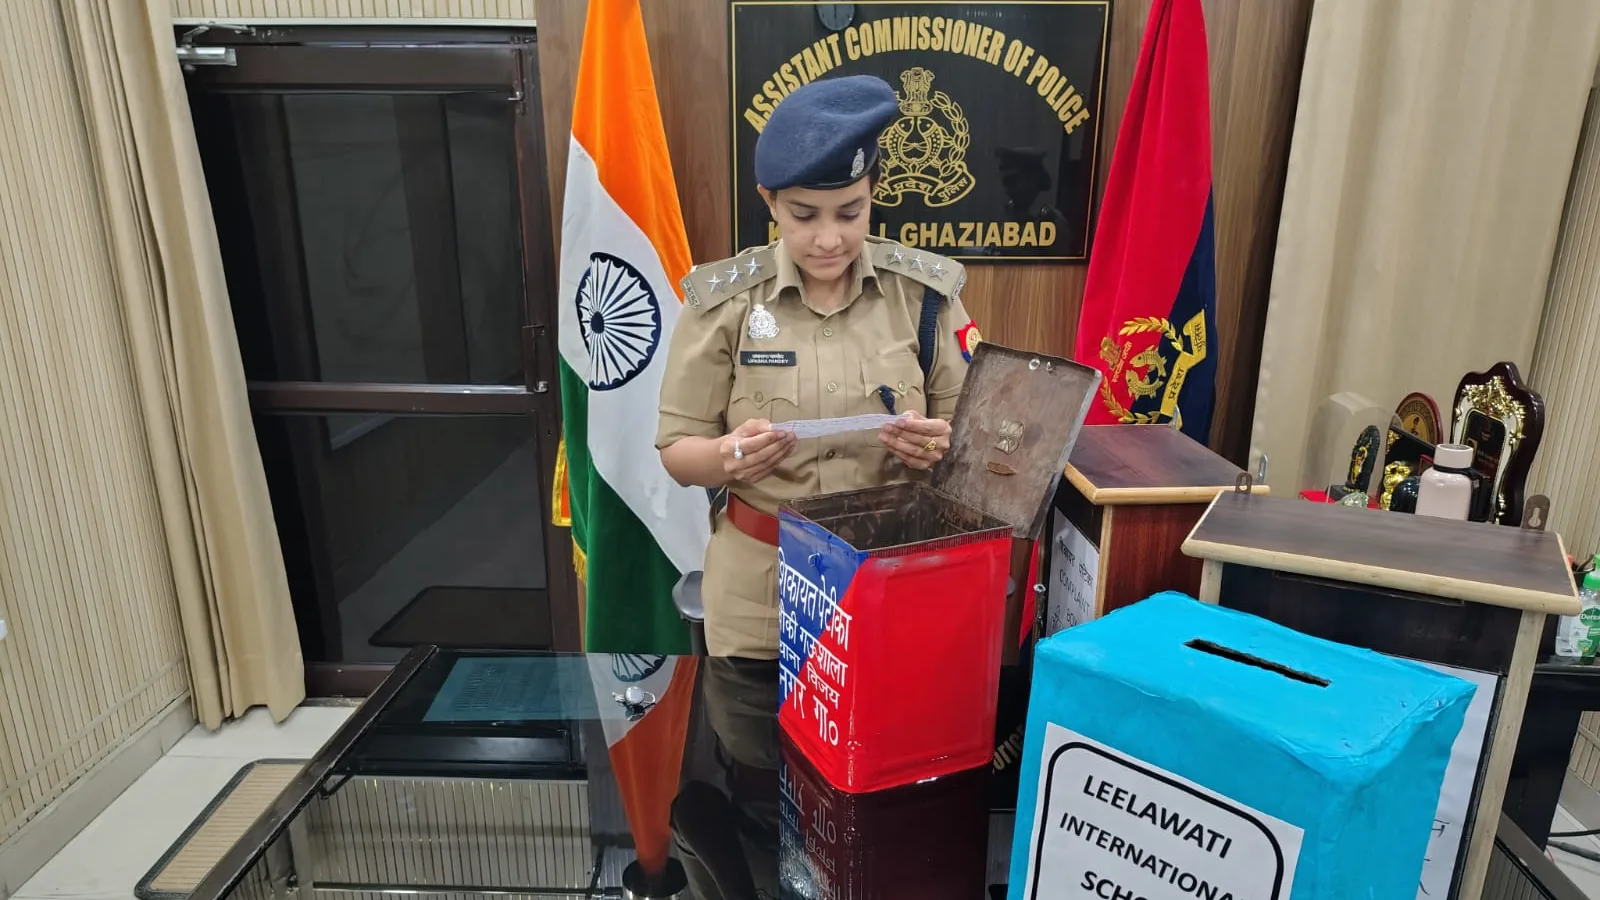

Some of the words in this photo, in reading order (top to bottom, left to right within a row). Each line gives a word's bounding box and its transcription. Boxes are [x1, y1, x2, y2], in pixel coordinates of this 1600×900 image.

[743, 32, 843, 135] ASSISTANT
[844, 16, 1006, 66] COMMISSIONER
[1003, 39, 1035, 78] OF
[1026, 55, 1091, 135] POLICE
[937, 177, 968, 202] पुलिस
[900, 222, 1057, 248] GHAZIABAD
[780, 660, 807, 719] नगर
[807, 661, 840, 710] विजय
[1083, 774, 1233, 859] LEELAWATI
